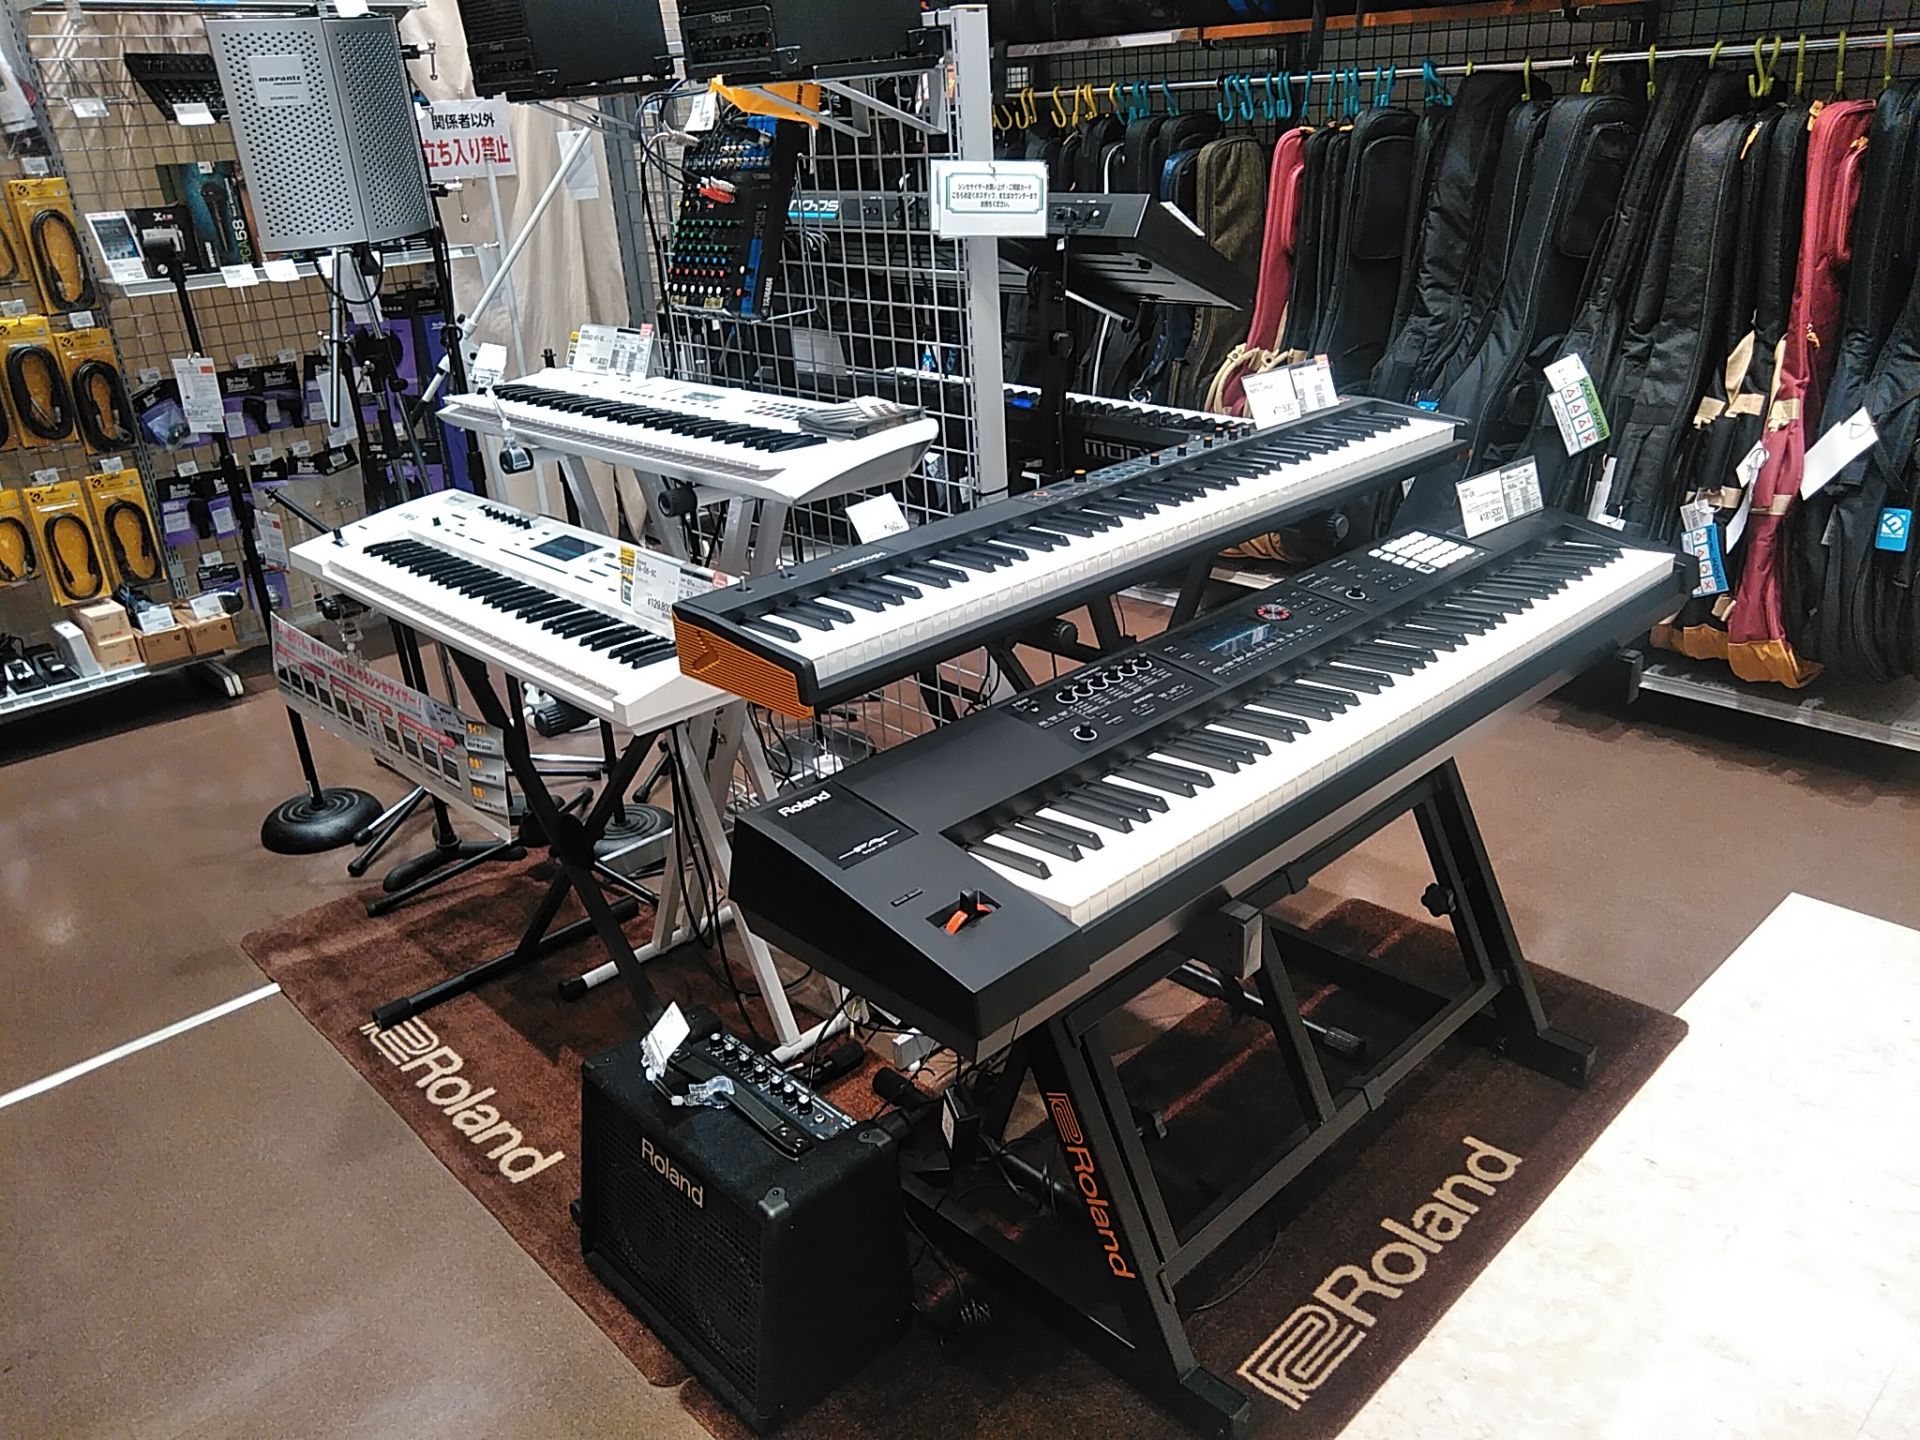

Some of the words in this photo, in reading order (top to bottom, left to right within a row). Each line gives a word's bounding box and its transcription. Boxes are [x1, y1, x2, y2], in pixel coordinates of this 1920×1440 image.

[711, 12, 732, 24] Roland
[258, 75, 301, 83] marantz
[432, 112, 495, 130] 関係者以外
[423, 135, 511, 168] 立ち入り禁止
[763, 277, 774, 307] YAMAHA
[1084, 438, 1150, 461] MOD
[777, 789, 832, 818] Roland
[402, 1045, 564, 1184] Roland
[640, 1136, 705, 1210] Roland
[1064, 1146, 1136, 1280] Roland
[1313, 1135, 1523, 1327] Roland
